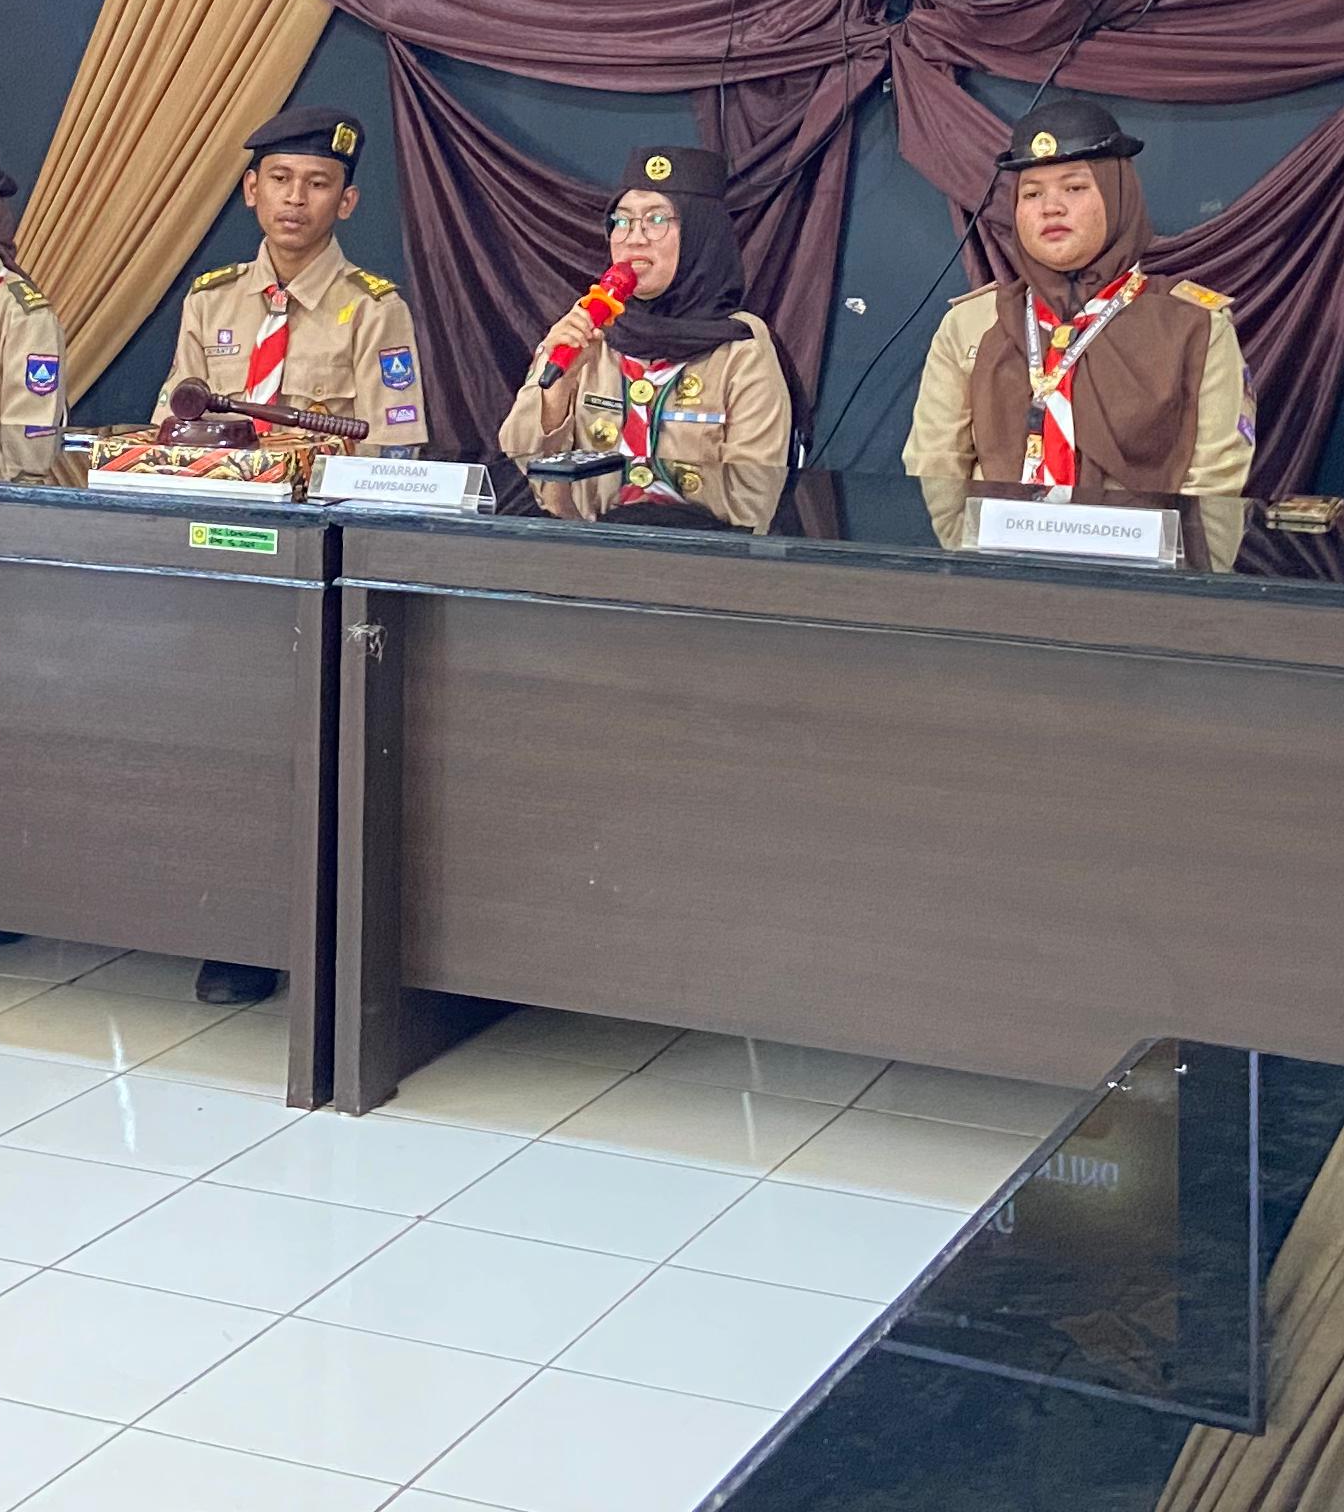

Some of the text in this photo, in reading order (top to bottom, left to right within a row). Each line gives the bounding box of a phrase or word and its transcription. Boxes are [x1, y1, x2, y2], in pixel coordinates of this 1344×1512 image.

[371, 464, 428, 478] KWARRAN
[354, 479, 438, 494] LEUWISADENG
[1006, 518, 1143, 539] DKR LEUWISADENG
